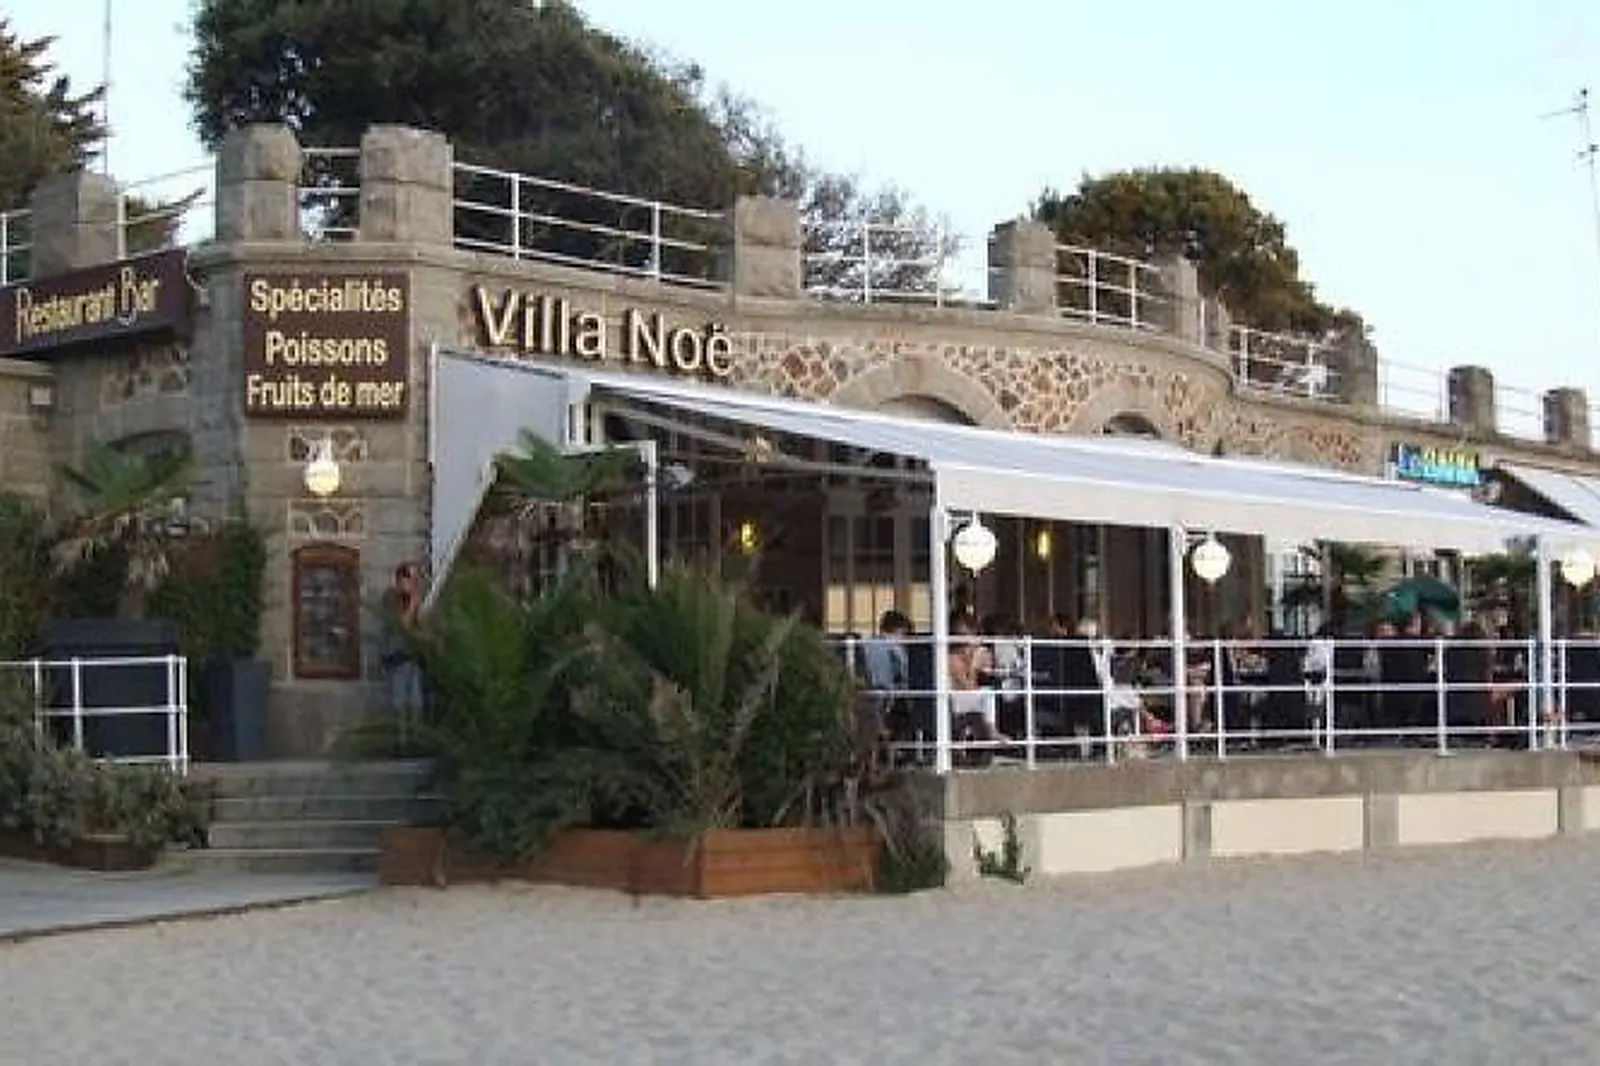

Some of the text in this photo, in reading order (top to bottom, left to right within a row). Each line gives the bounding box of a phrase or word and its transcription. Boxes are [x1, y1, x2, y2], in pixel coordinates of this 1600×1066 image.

[15, 266, 160, 345] Restaurant Bar
[250, 279, 402, 320] Spécialités
[265, 330, 388, 366] Poissons
[475, 284, 734, 376] Villa Noë
[247, 373, 404, 407] Fruits de mer
